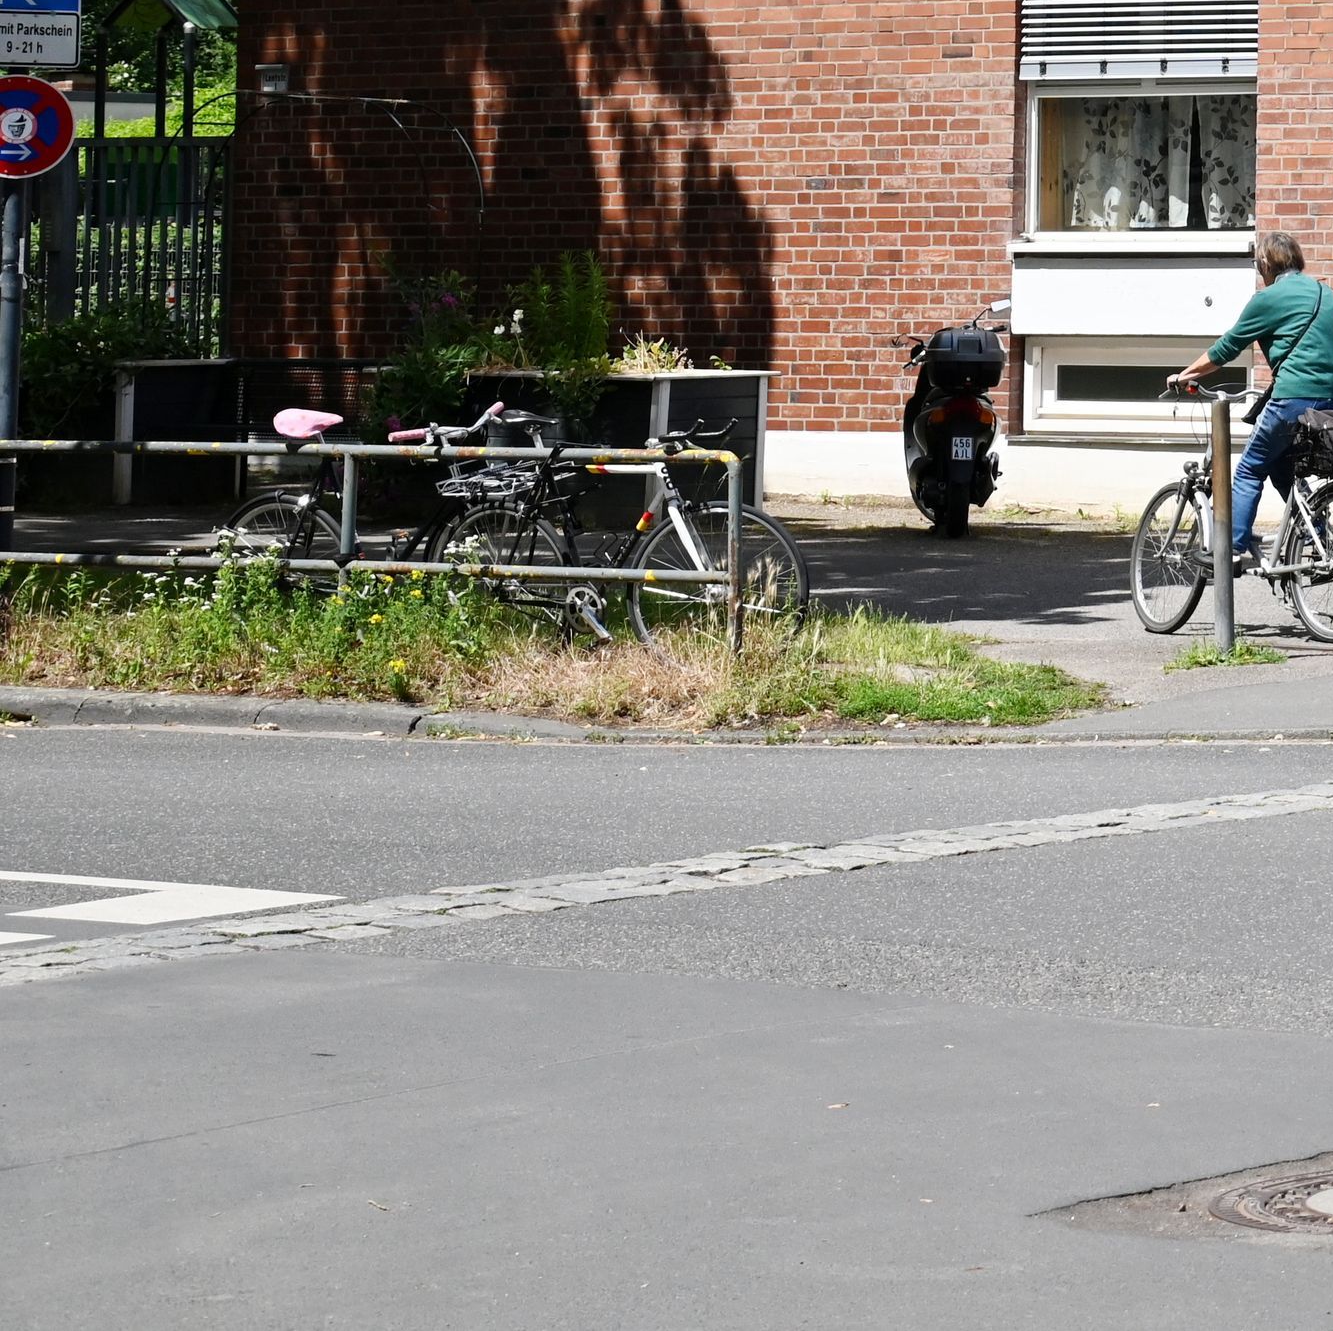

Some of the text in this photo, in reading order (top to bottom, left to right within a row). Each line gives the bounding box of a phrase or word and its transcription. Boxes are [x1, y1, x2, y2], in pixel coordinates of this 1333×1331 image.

[17, 23, 72, 37] Parkschein
[6, 42, 12, 53] 9
[22, 42, 33, 53] 21
[36, 42, 43, 54] h
[953, 438, 970, 448] 456
